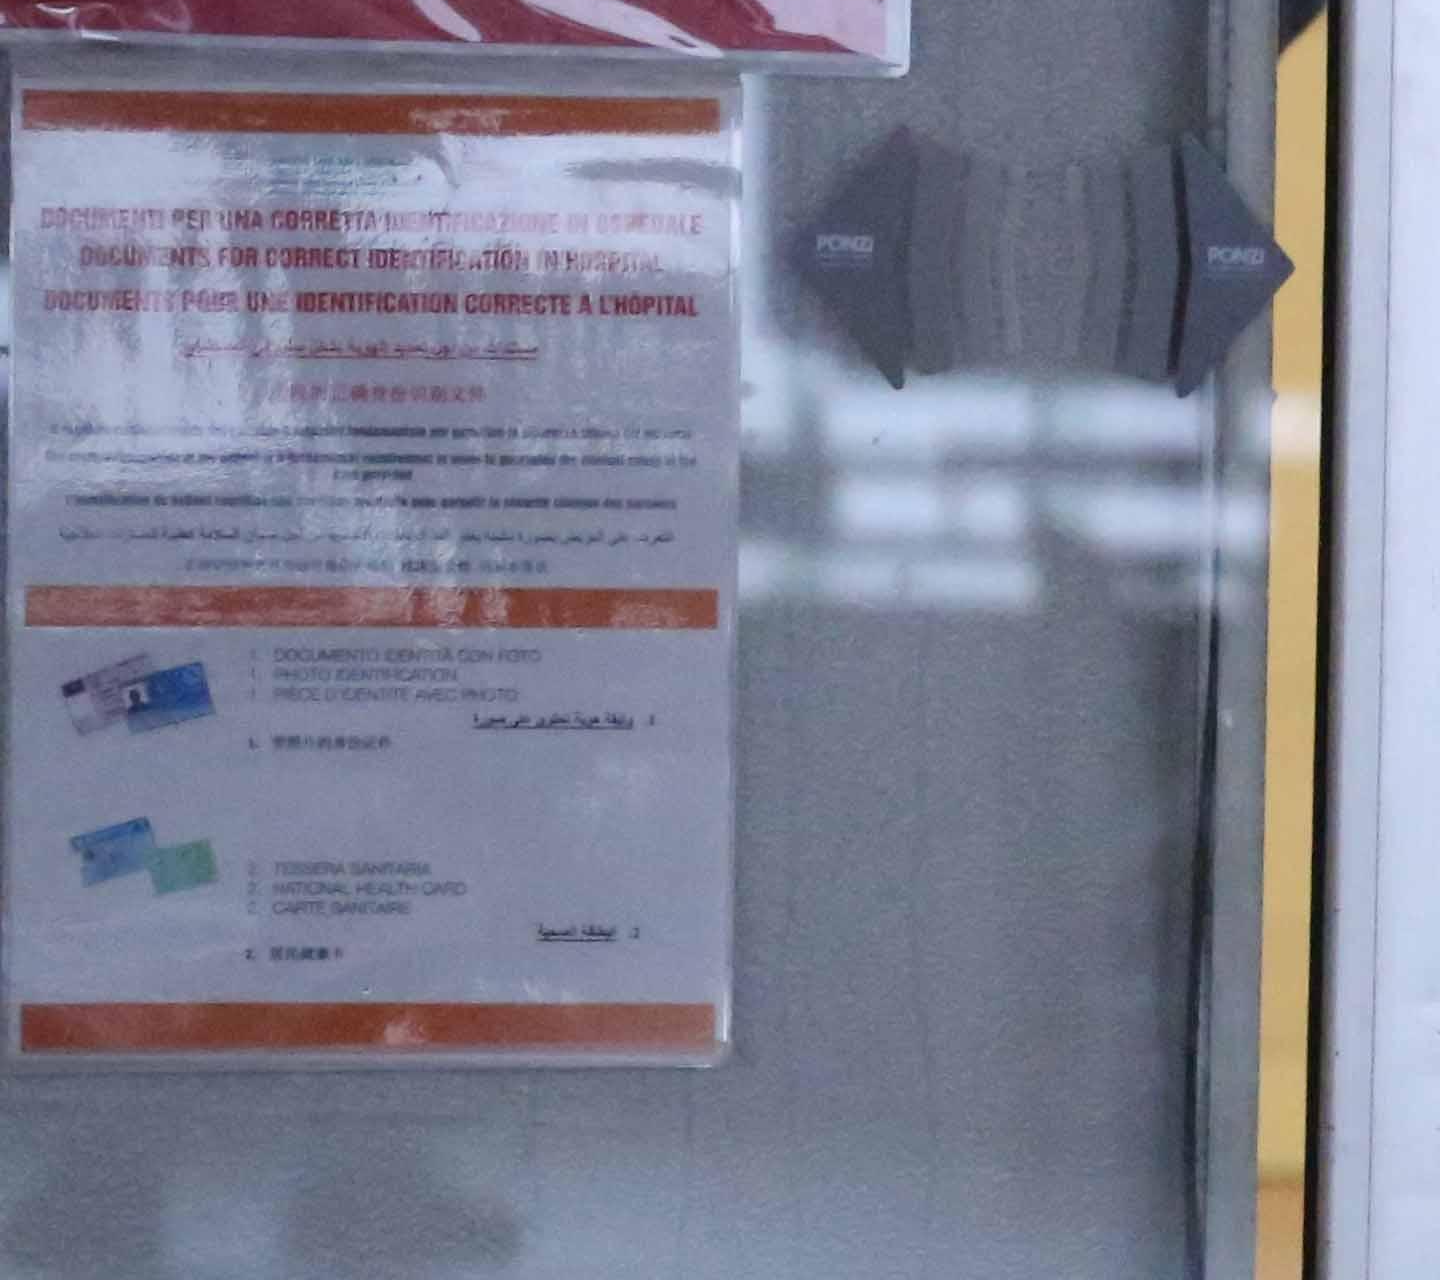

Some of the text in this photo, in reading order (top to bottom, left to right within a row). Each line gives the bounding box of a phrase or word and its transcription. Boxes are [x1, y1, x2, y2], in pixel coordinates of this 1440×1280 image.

[270, 209, 377, 233] CORRETTA
[218, 246, 257, 268] FOR
[265, 247, 358, 270] CORRECT
[295, 291, 458, 315] IDENTIFICATION
[464, 293, 572, 317] CORRECTE
